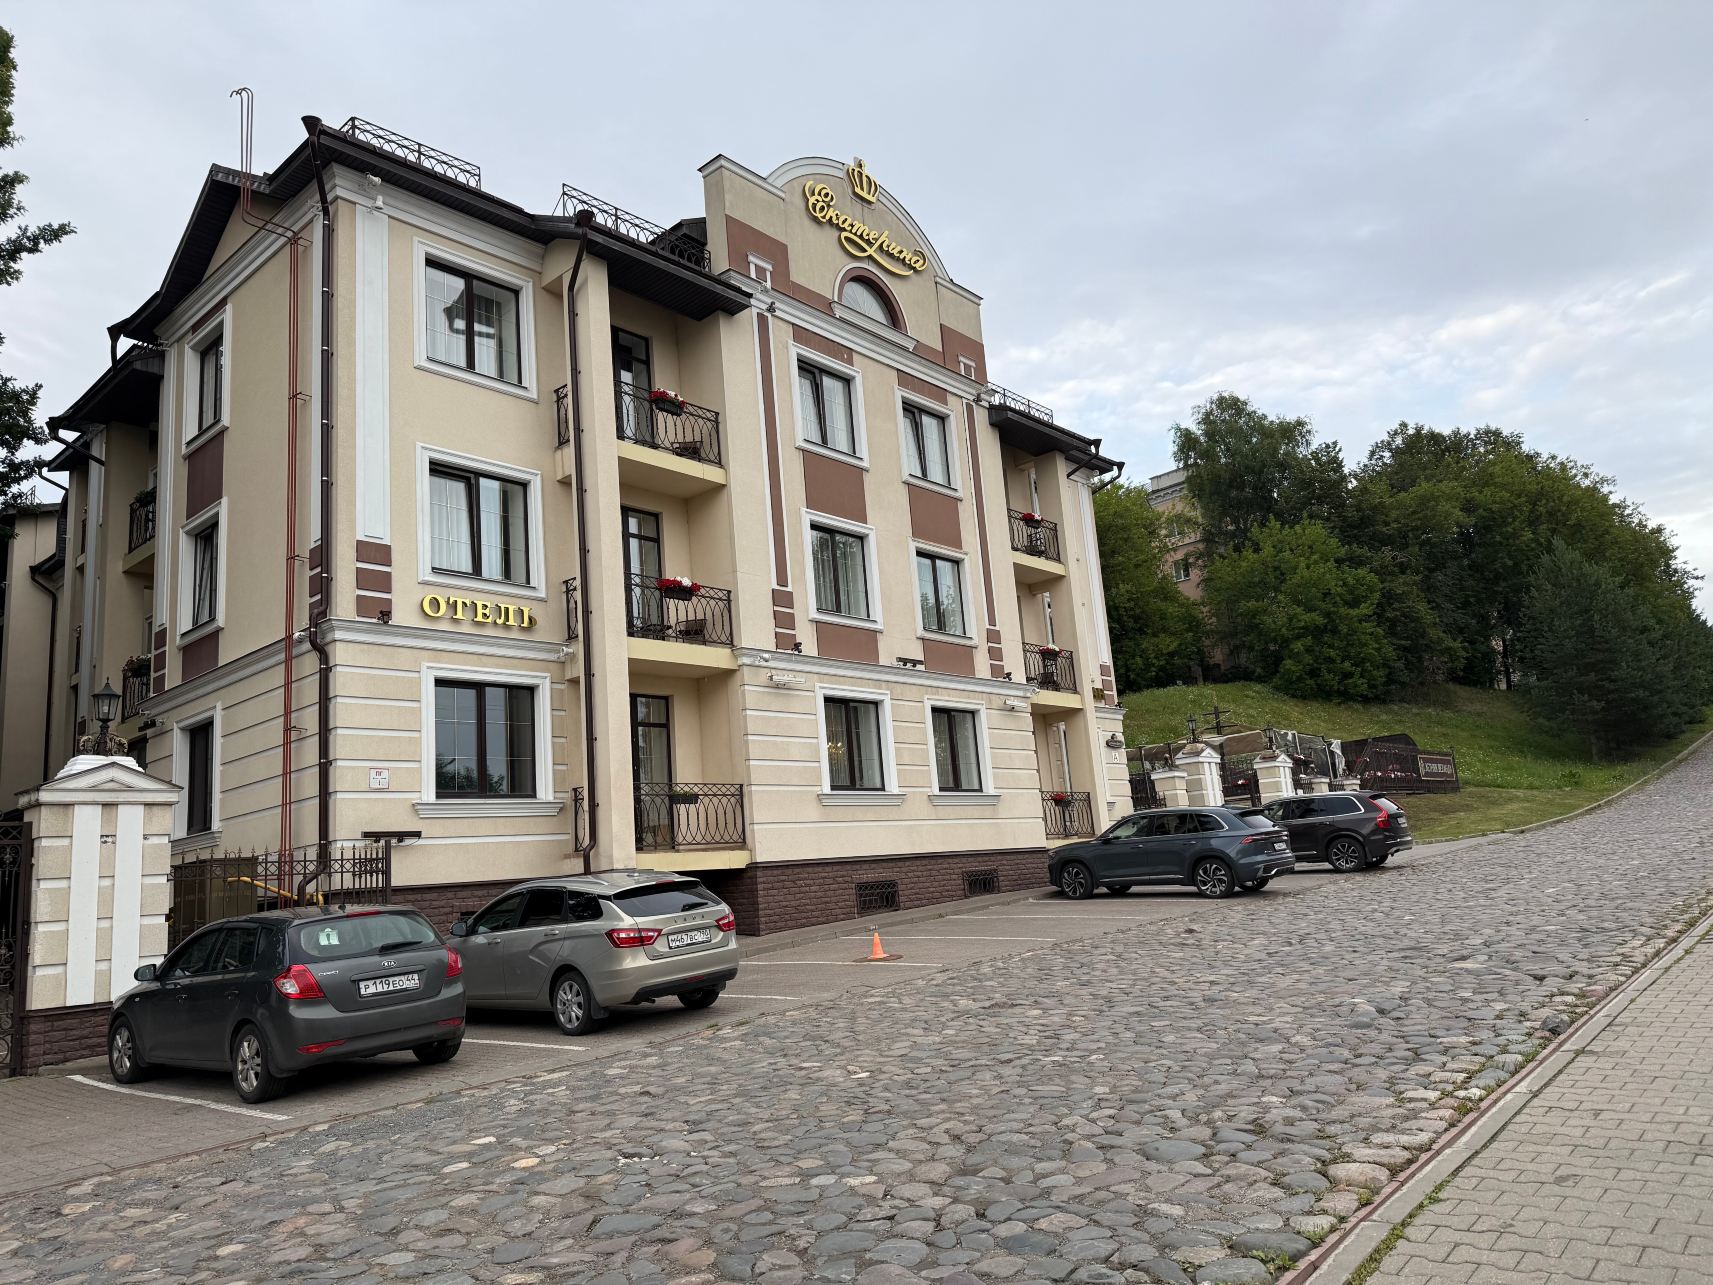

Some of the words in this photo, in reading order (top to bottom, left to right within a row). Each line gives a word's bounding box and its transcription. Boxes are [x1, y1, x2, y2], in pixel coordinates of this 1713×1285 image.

[804, 180, 927, 275] Екатерина
[422, 594, 537, 628] ОТЕЛЬ
[364, 979, 404, 992] Р119ЕО
